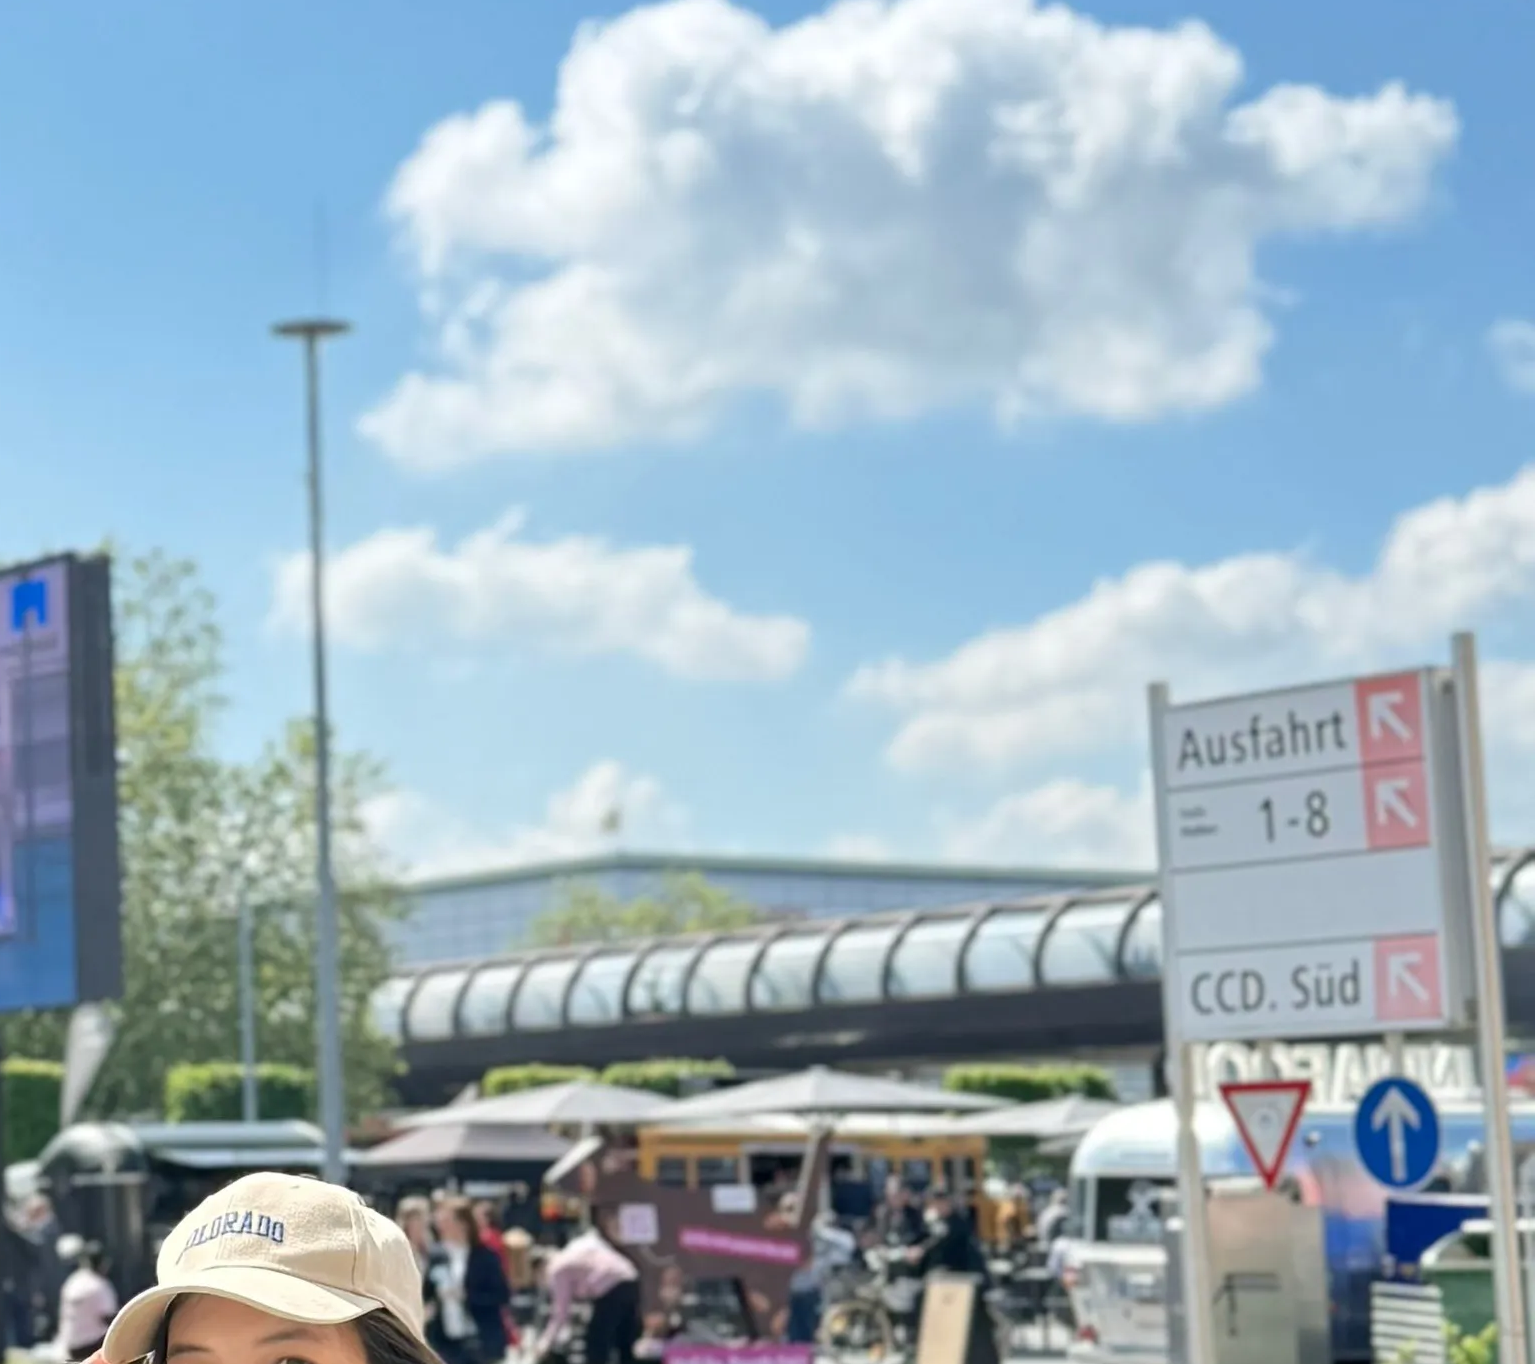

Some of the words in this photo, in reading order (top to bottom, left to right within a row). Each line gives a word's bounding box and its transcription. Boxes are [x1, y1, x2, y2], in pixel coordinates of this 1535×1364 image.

[1177, 709, 1347, 772] Ausfahrt
[1290, 957, 1361, 1011] Süd
[177, 1210, 284, 1258] OLORADO
